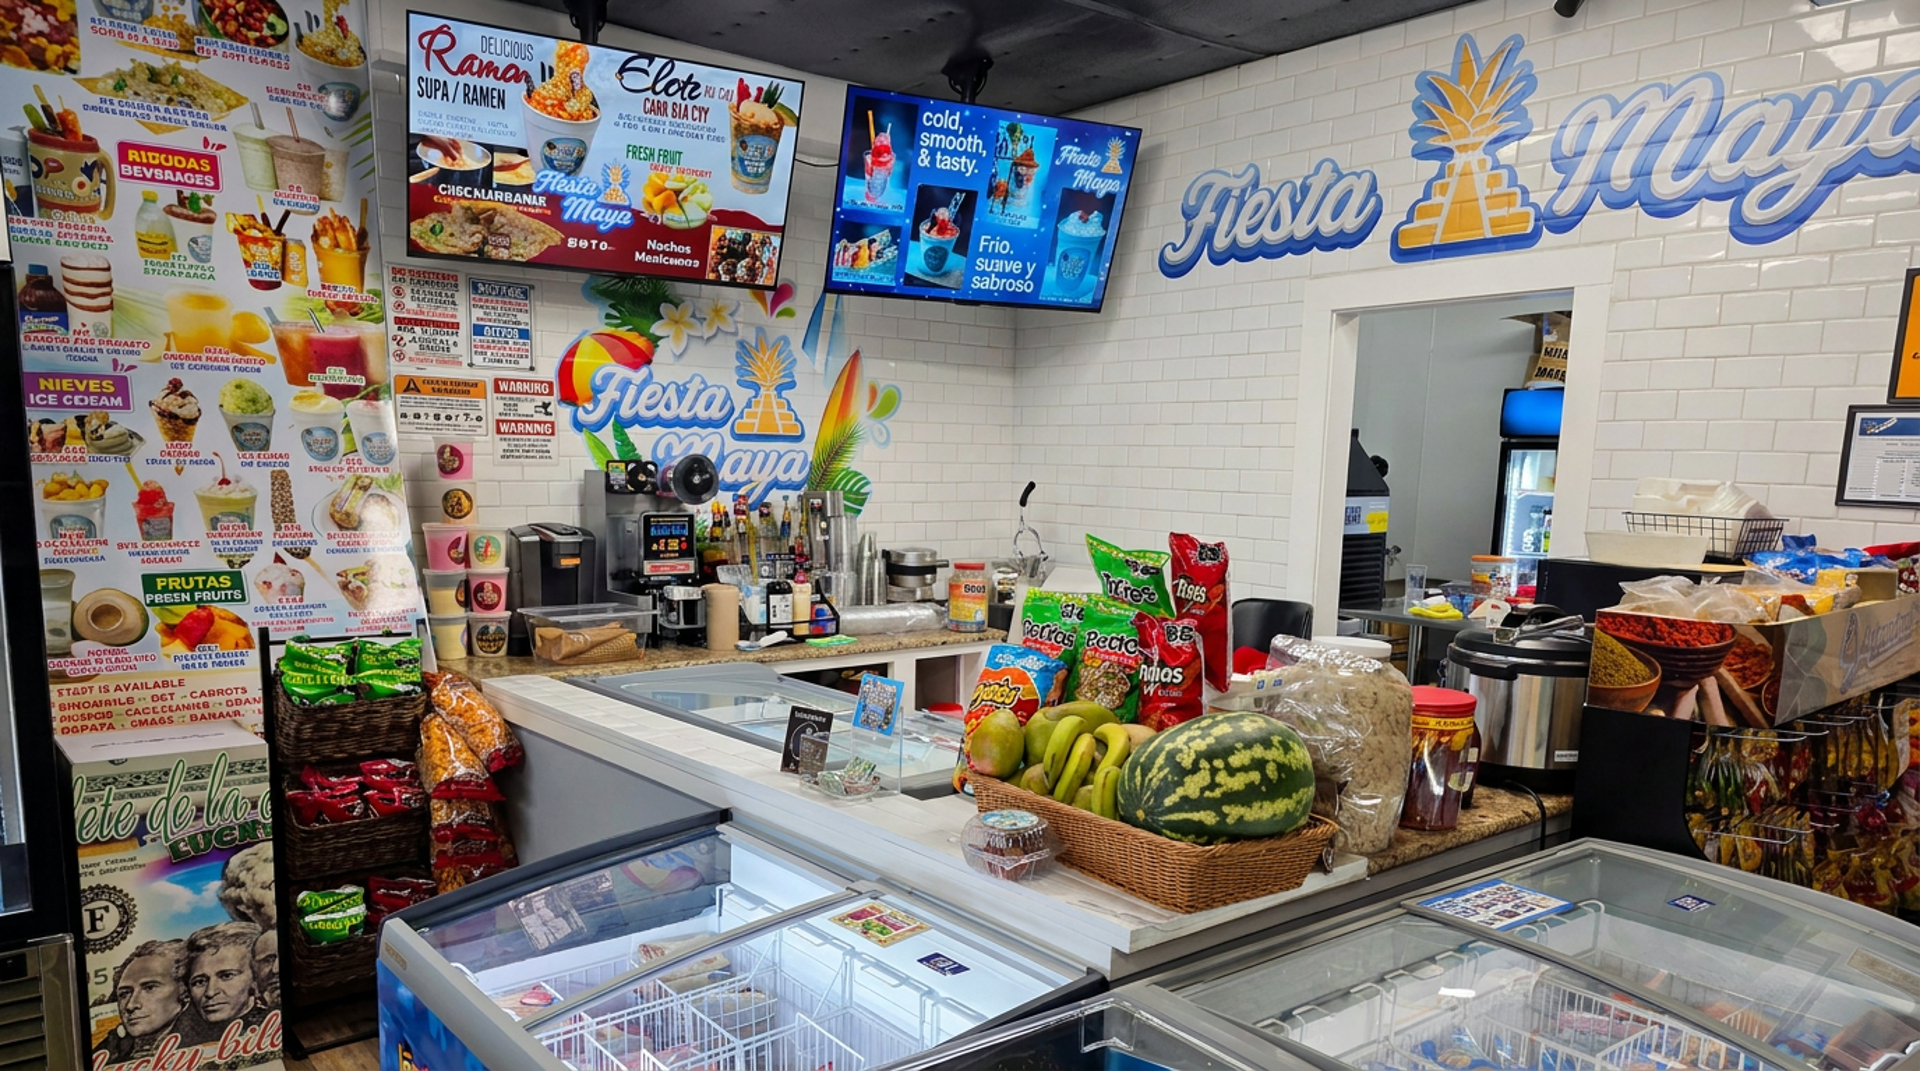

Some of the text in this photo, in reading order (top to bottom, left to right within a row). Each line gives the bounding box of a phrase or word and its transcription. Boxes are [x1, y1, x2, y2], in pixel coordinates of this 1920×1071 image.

[480, 34, 534, 62] DELICIOUS
[416, 76, 449, 102] SUPA
[463, 83, 506, 110] RAMEN
[922, 110, 963, 134] cold,
[626, 144, 656, 162] FRESH
[919, 130, 987, 157] smooth,
[917, 150, 979, 178] & tasty.
[1160, 159, 1383, 276] Fiesta
[978, 235, 1014, 255] Frio.
[1025, 261, 1036, 280] y
[971, 274, 1034, 294] sabroso
[39, 378, 115, 393] NIEVES
[572, 364, 735, 431] Fiesta
[29, 393, 58, 405] ICE
[99, 684, 110, 694] IS
[114, 678, 186, 693] AVAILABLE
[147, 758, 196, 845] de
[204, 751, 251, 827] la
[85, 904, 110, 935] F
